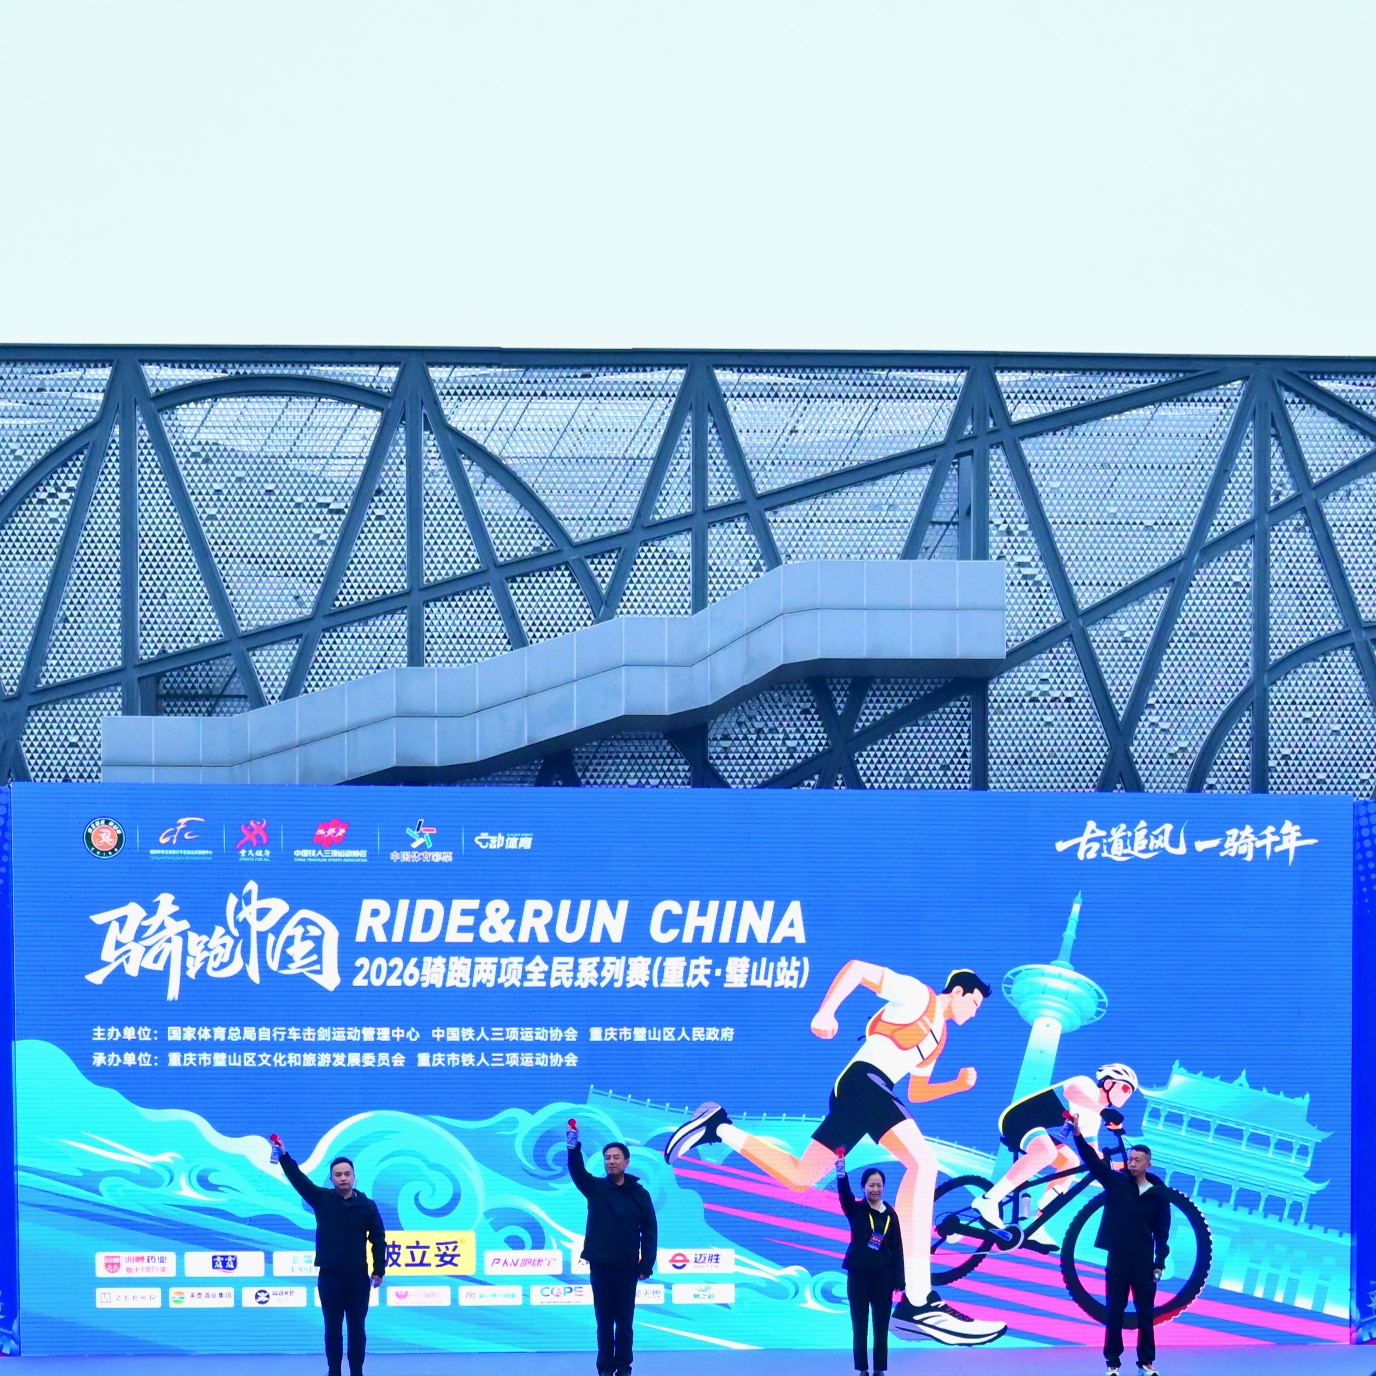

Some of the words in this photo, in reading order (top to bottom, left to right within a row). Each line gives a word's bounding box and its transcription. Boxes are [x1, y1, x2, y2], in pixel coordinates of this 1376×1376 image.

[1055, 820, 1190, 862] 古道追风
[1194, 821, 1319, 866] 一骑千年
[84, 880, 341, 1001] 骑跑中国
[355, 899, 629, 944] RIDE&RUN
[649, 899, 807, 944] CHINA
[432, 1026, 578, 1042] 中国铁人三项运动协会
[417, 1052, 578, 1067] 重庆市铁人三项运动协会
